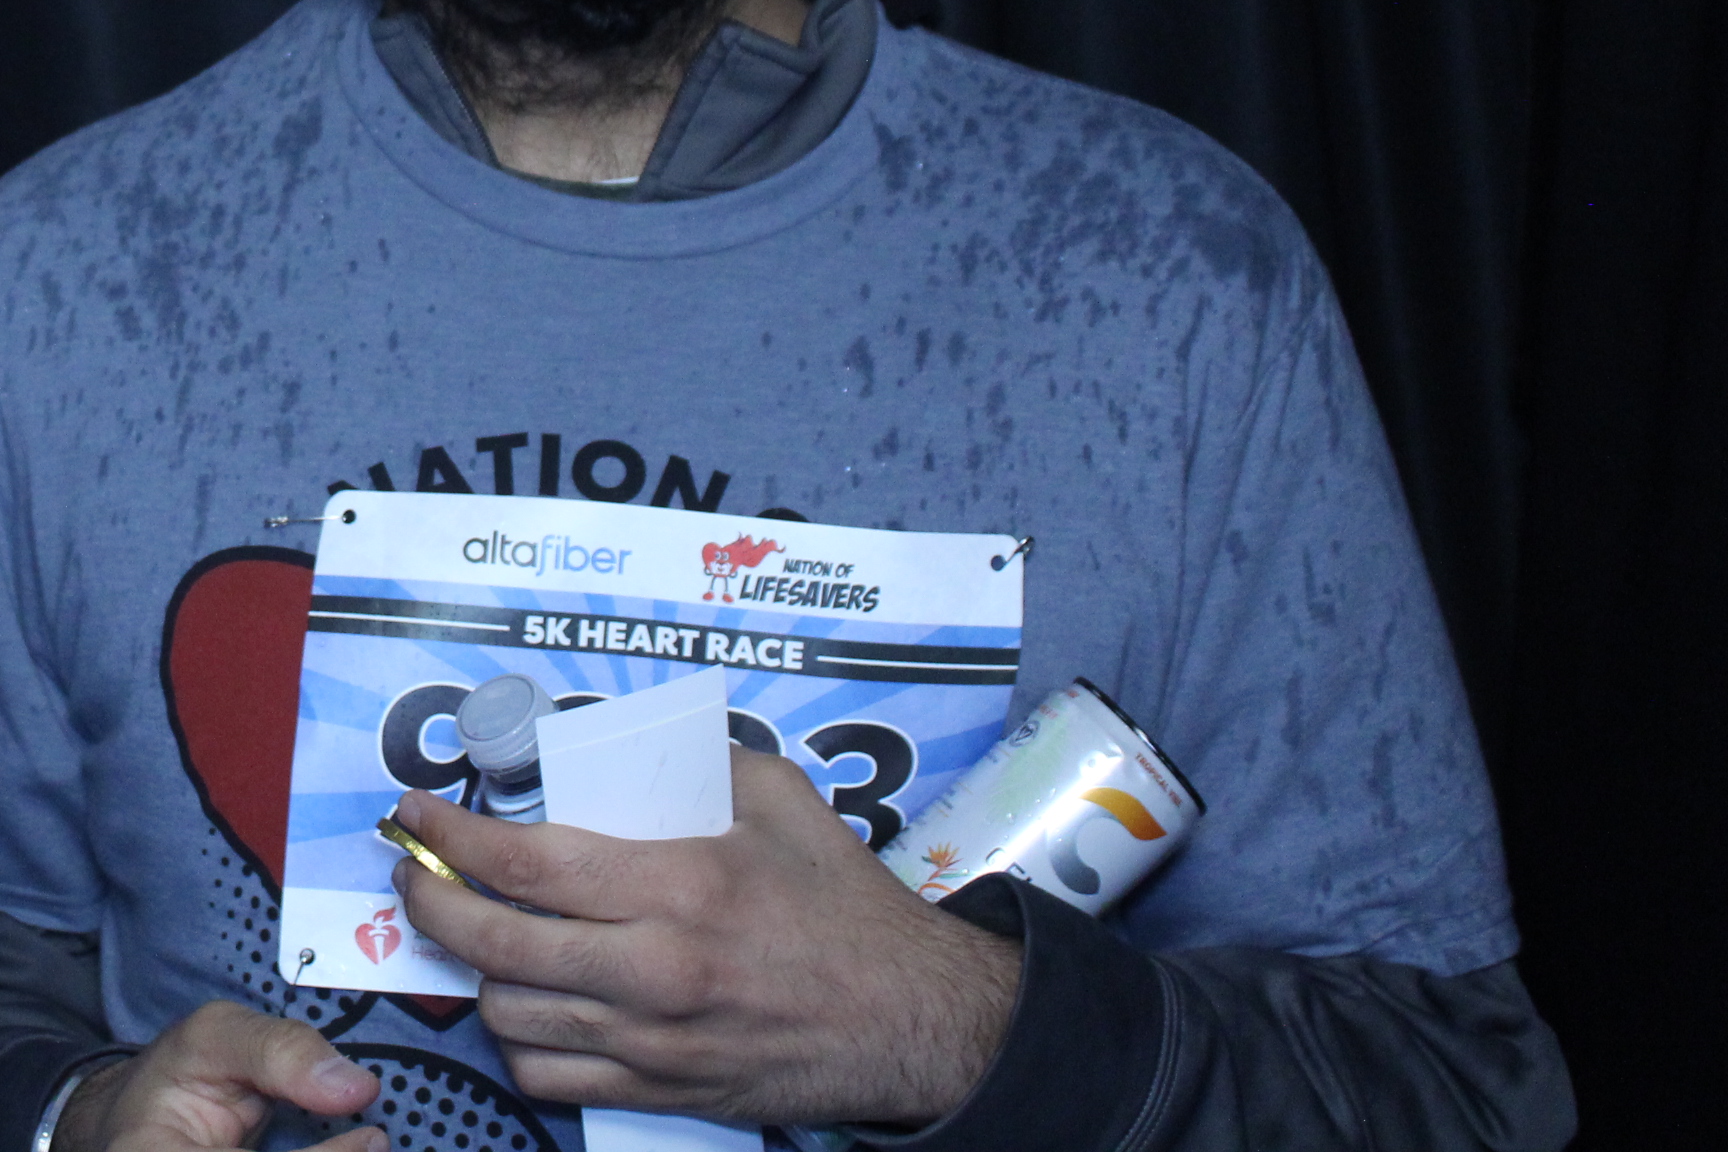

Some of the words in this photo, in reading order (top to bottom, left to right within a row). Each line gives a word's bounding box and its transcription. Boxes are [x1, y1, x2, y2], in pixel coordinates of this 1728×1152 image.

[462, 530, 633, 577] altafiber
[782, 558, 834, 578] NATION
[835, 563, 855, 579] OF
[738, 574, 882, 614] LIFESAVERS
[523, 615, 572, 647] 5K
[577, 619, 701, 659] HEART
[705, 634, 805, 671] RACE
